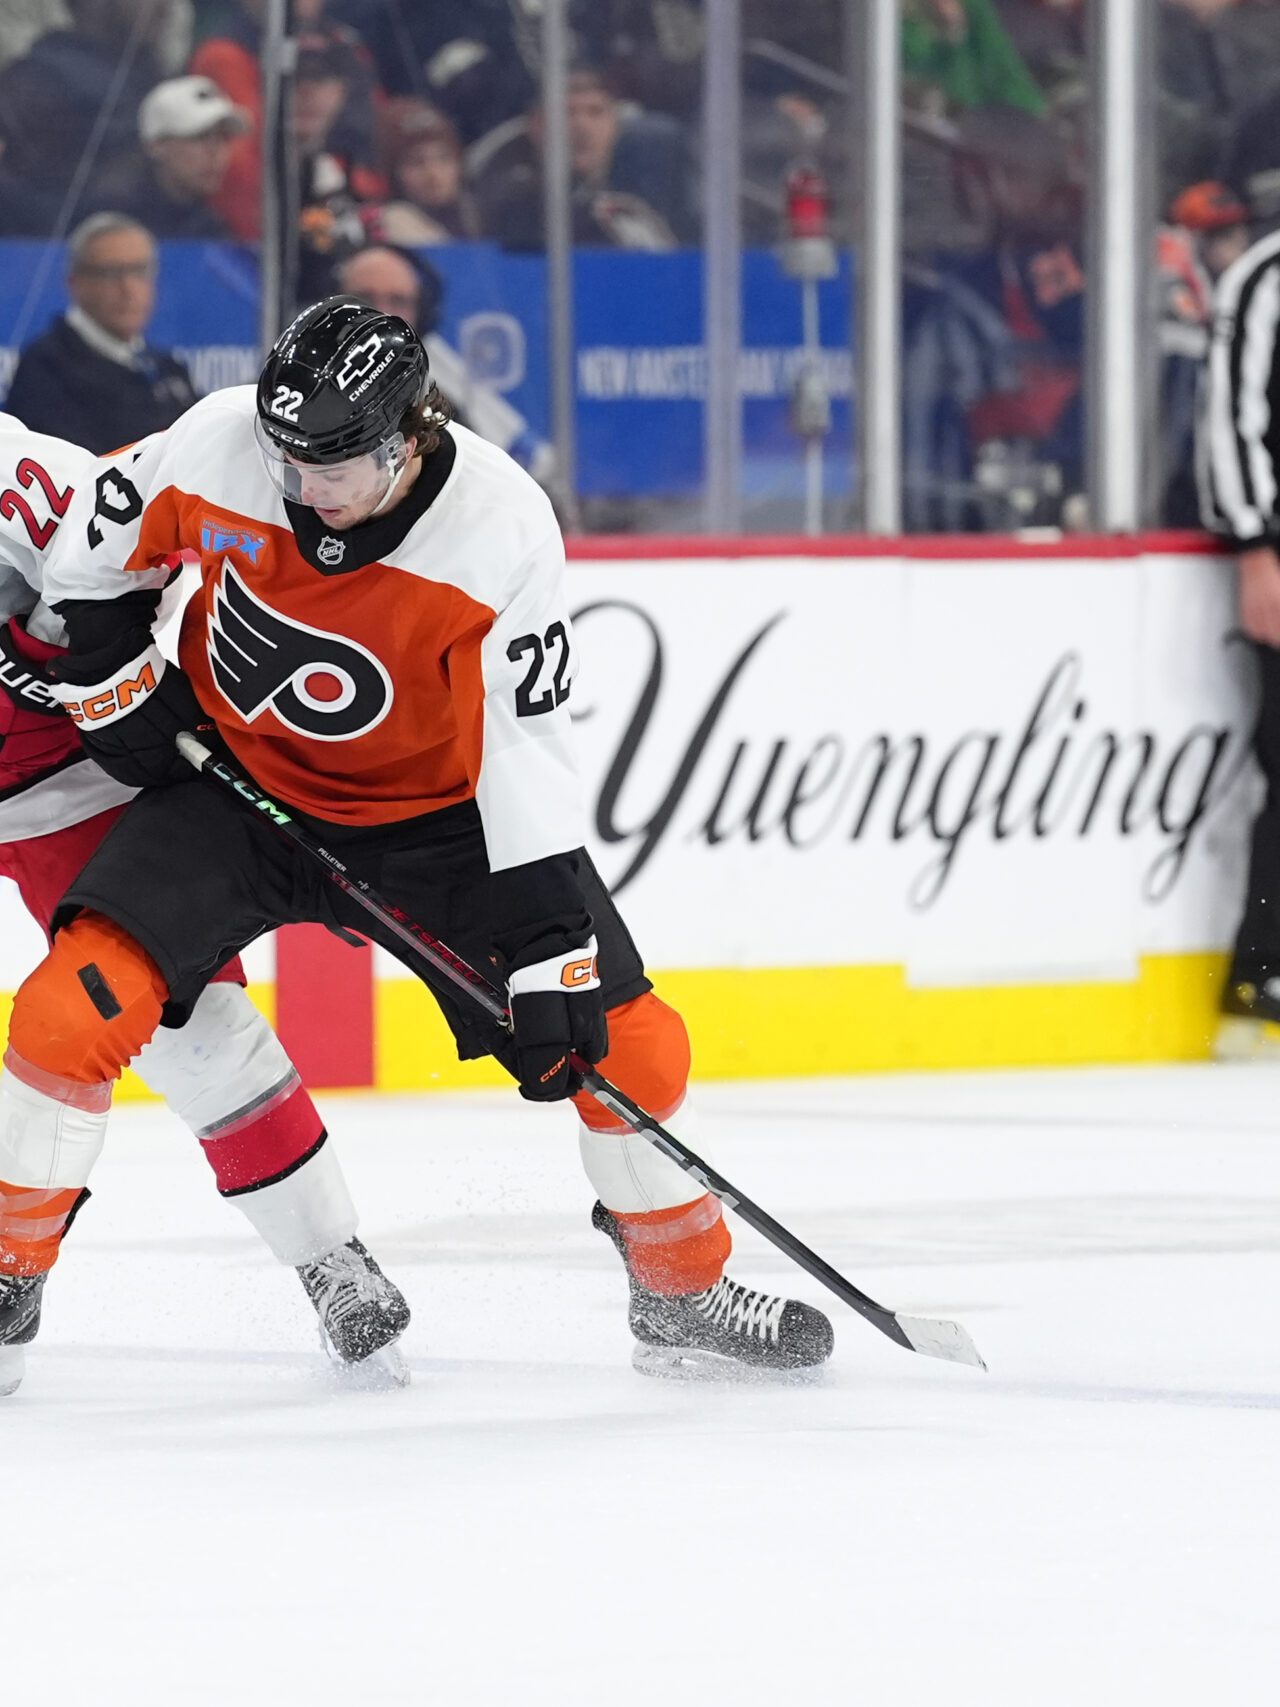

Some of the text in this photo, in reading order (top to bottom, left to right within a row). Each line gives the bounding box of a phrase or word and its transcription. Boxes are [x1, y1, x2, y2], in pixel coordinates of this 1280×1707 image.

[348, 349, 396, 402] CHEVROLET
[271, 385, 304, 423] 22
[268, 427, 309, 448] CCM
[201, 527, 266, 565] IBX
[506, 620, 571, 717] 22
[63, 660, 157, 724] CCM
[568, 600, 1232, 910] Yuengling
[318, 847, 347, 872] PELLETIER
[382, 904, 483, 984] JETSPEED
[540, 1056, 566, 1083] CCM
